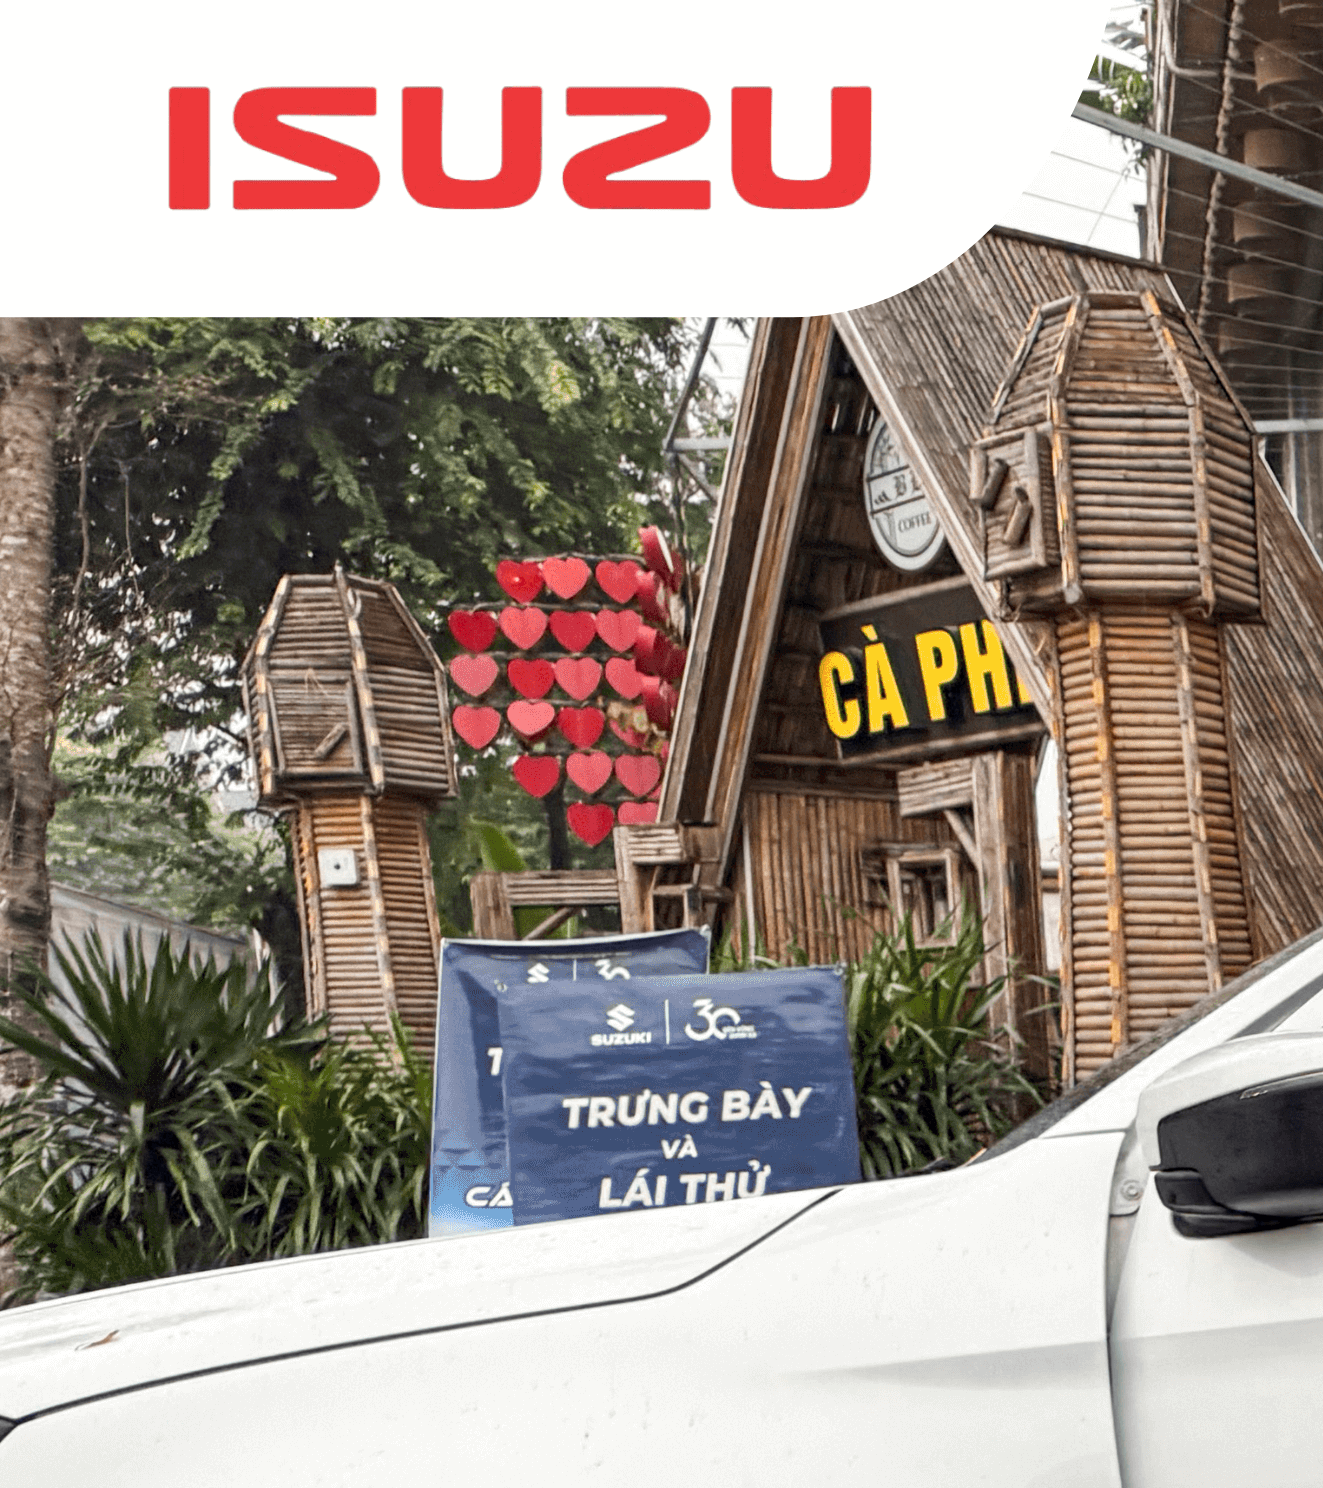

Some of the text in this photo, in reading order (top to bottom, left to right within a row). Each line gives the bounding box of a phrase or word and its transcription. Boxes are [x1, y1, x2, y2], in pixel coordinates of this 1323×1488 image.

[819, 619, 1032, 740] CÀ PH
[591, 1031, 652, 1047] SUZUKI
[562, 1081, 813, 1129] TRƯNG BÀY
[661, 1134, 698, 1160] VÀ
[599, 1159, 772, 1208] LÁI THỬ
